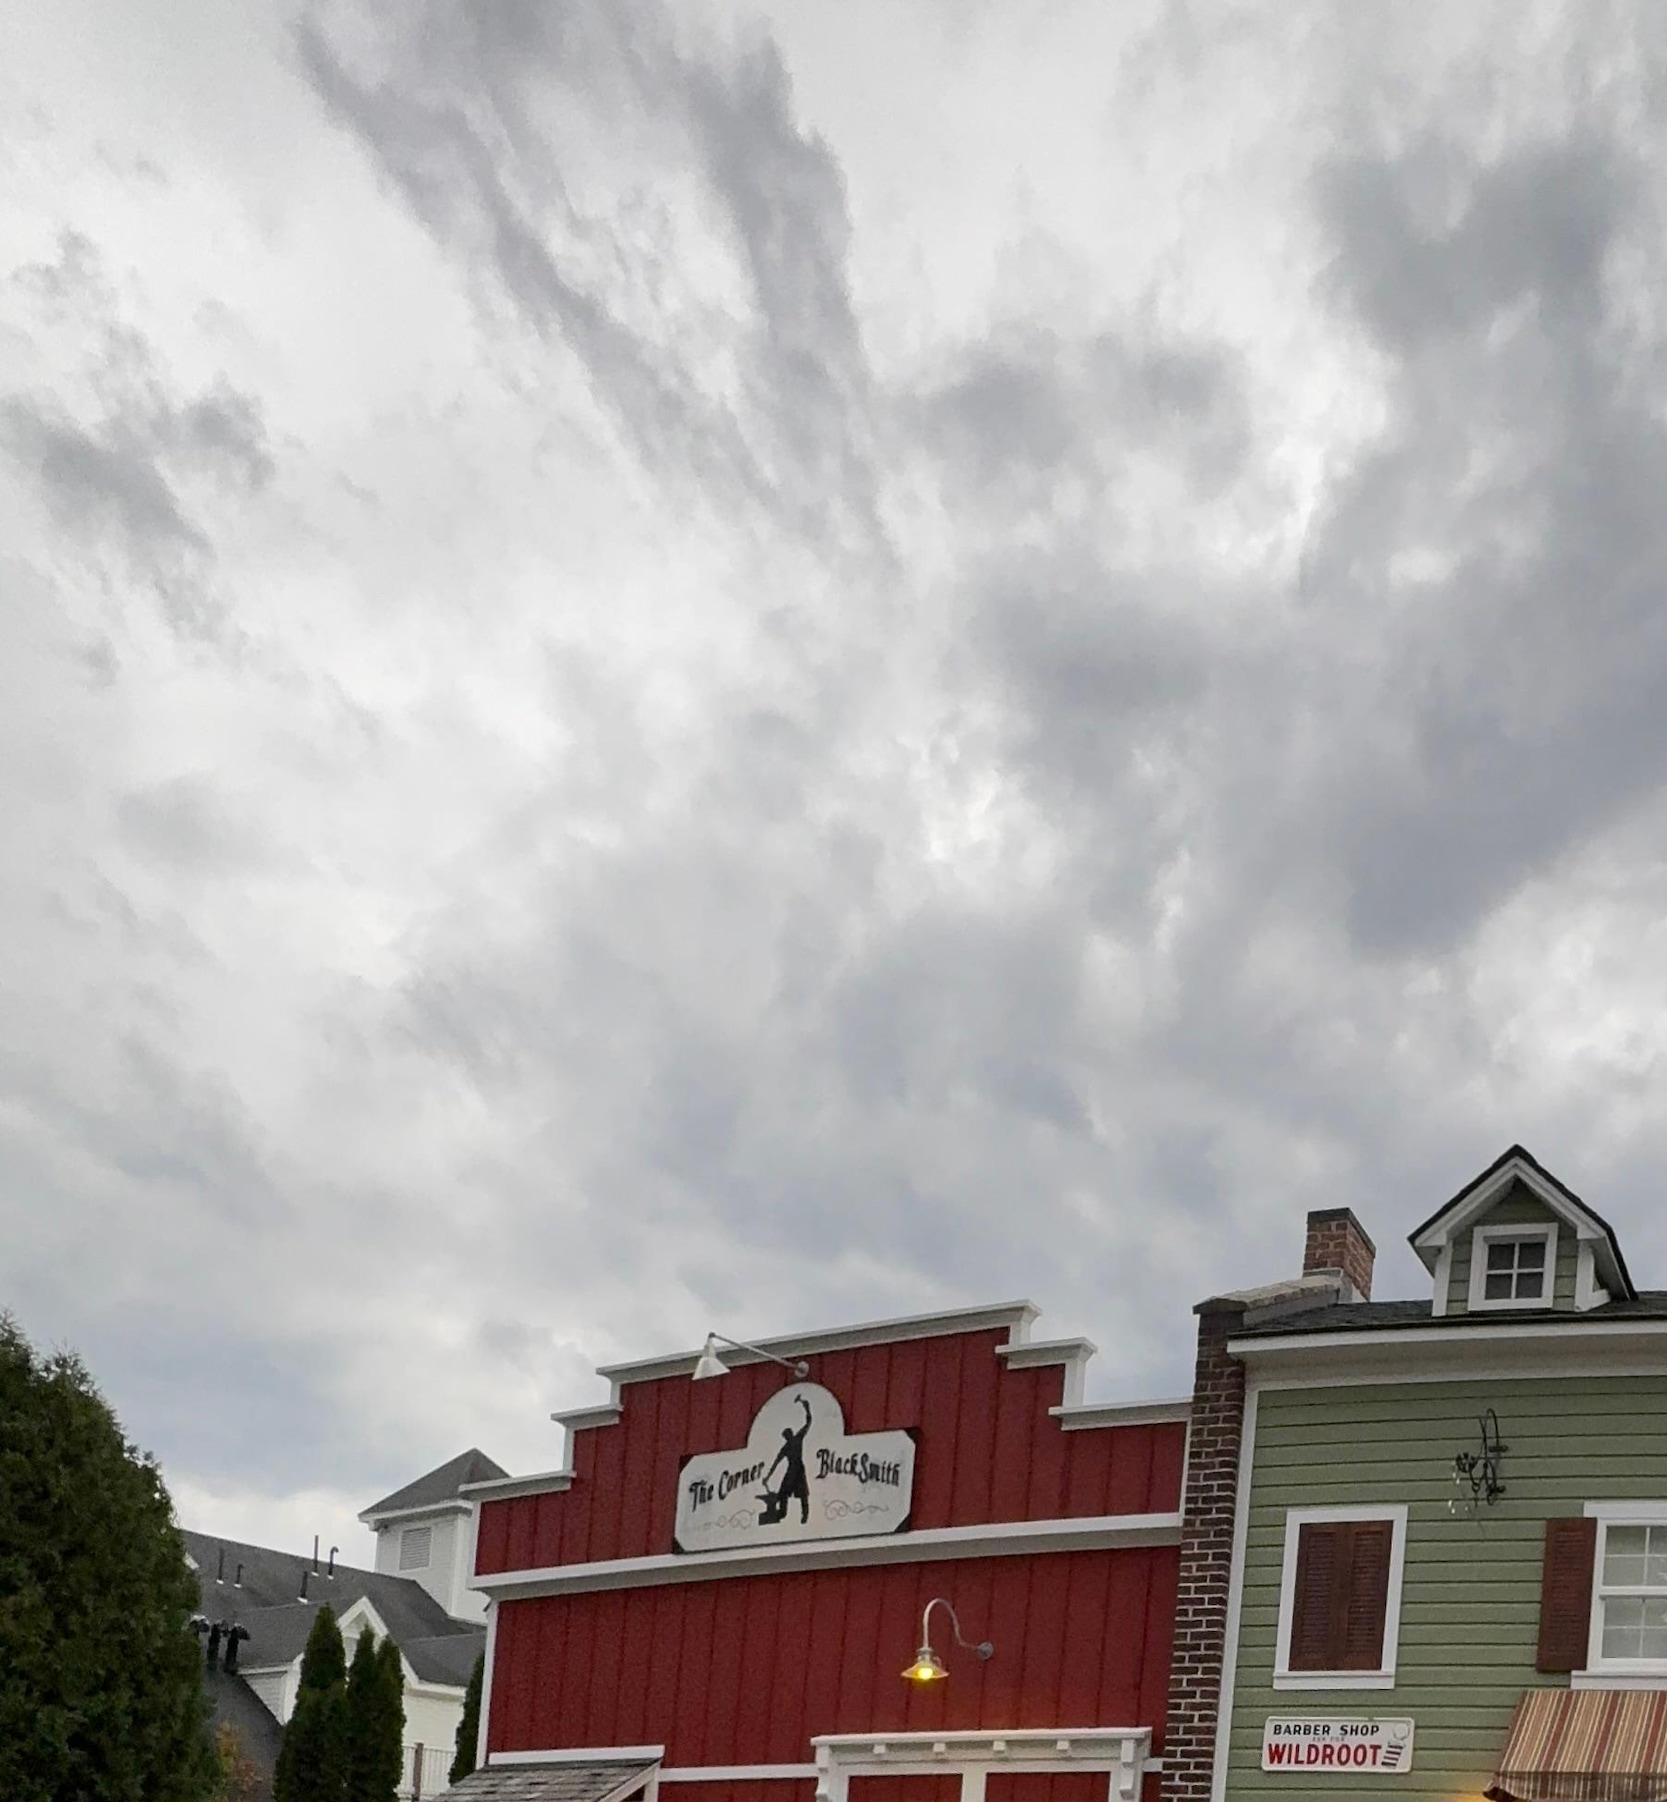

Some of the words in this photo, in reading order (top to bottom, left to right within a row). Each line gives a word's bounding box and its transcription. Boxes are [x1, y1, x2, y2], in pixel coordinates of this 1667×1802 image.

[689, 1479, 714, 1512] The
[718, 1461, 765, 1500] Corner
[1273, 1724, 1331, 1736] BARBER
[1339, 1724, 1380, 1736] SHOP
[1268, 1743, 1382, 1766] WILDROOT
